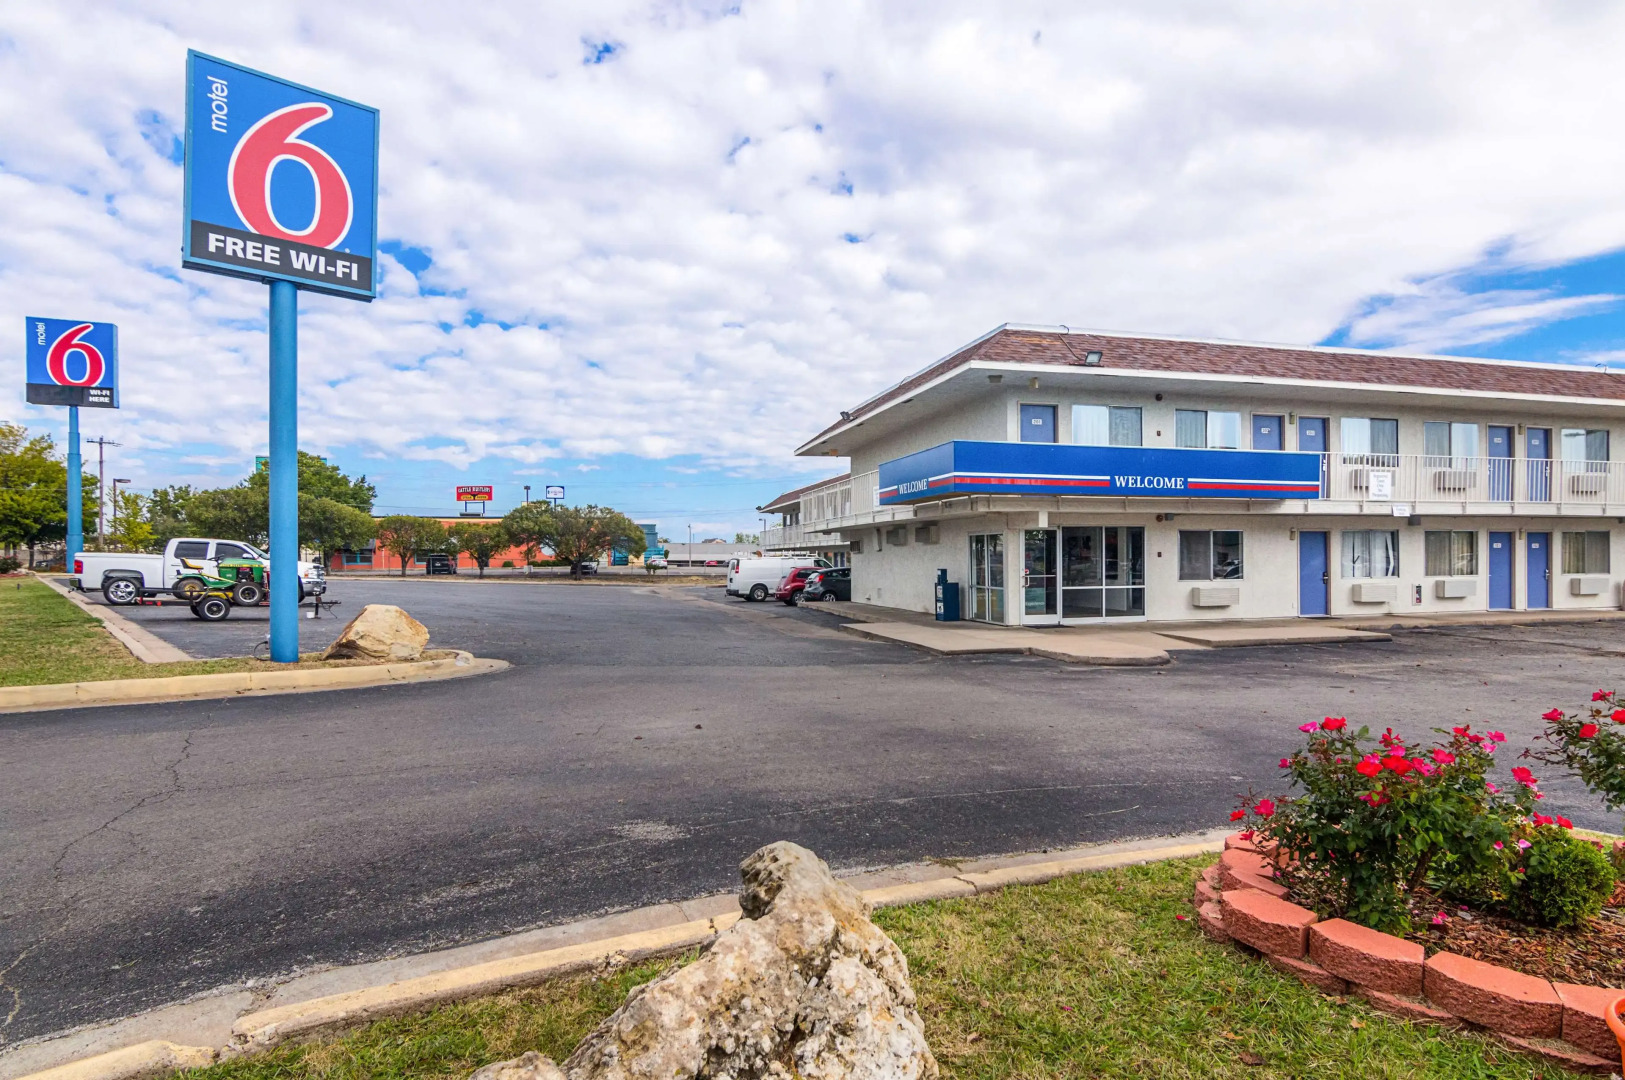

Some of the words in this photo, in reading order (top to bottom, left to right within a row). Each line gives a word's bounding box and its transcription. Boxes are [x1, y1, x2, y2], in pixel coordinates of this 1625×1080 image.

[207, 76, 228, 133] motel
[227, 102, 354, 250] 6
[208, 233, 281, 266] FREE
[289, 249, 358, 281] WI-FI
[35, 322, 46, 345] motel
[46, 323, 105, 387] 6
[899, 479, 927, 494] WELCOME
[1114, 475, 1184, 489] WELCOME
